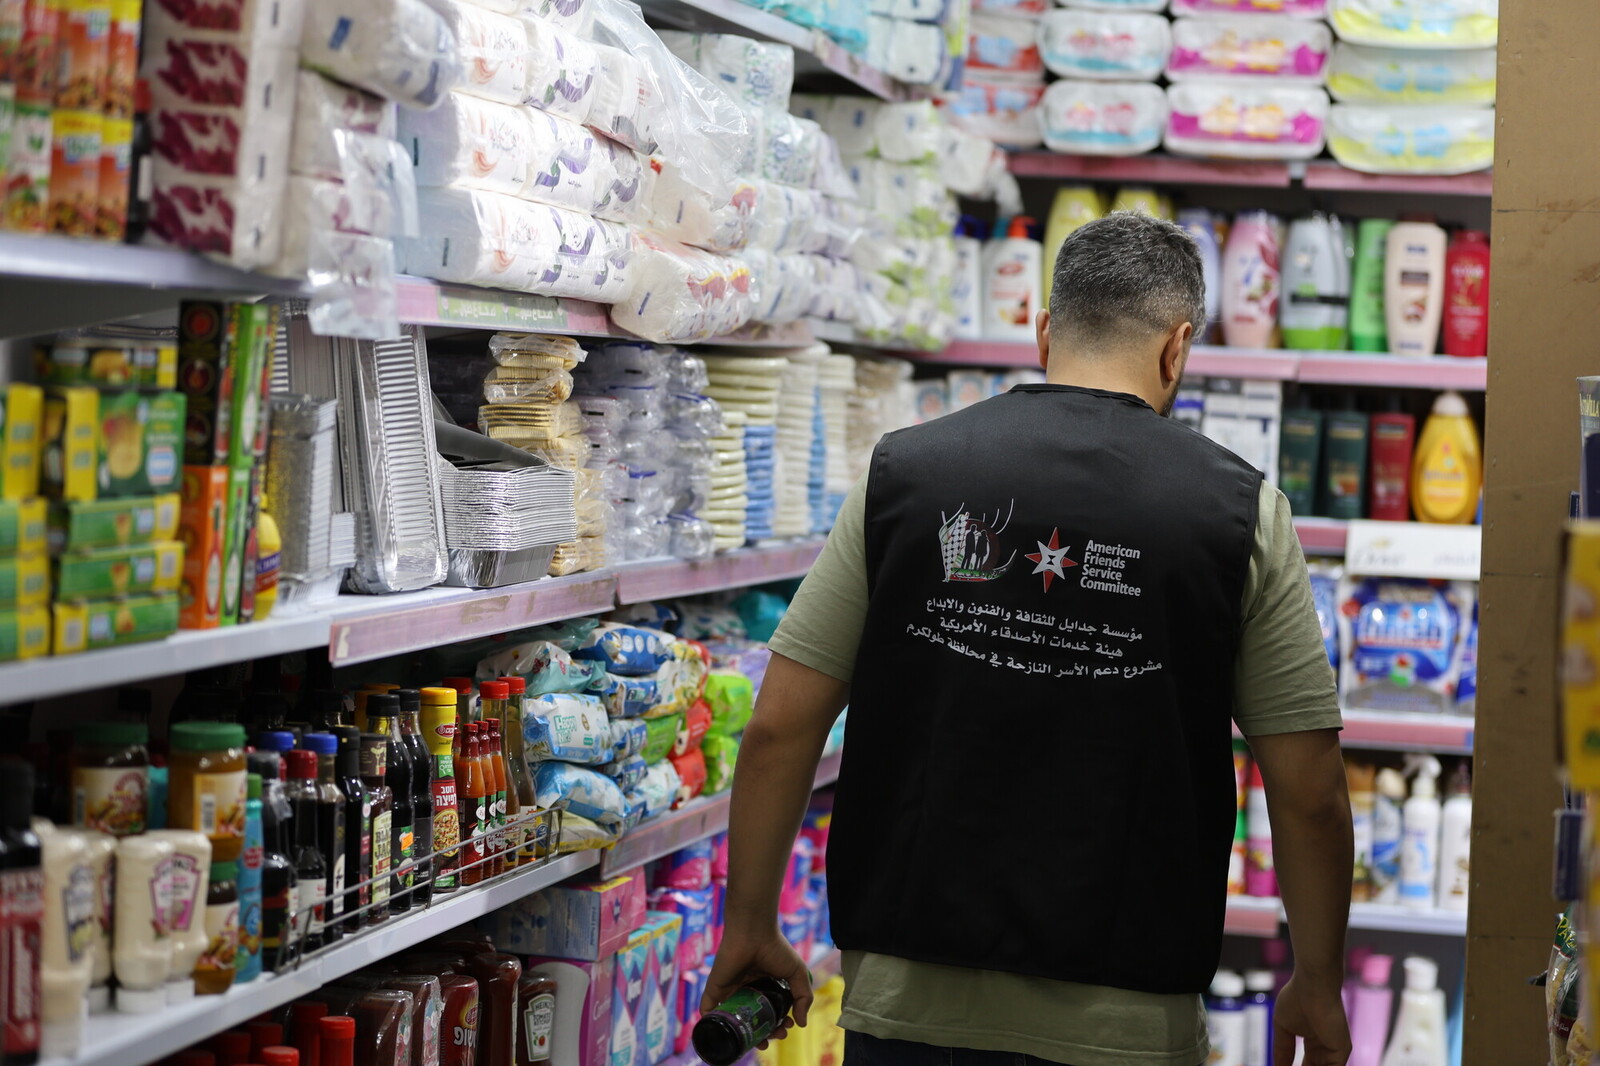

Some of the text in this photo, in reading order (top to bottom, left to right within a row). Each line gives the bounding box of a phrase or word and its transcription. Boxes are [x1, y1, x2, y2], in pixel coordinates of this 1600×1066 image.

[1086, 540, 1141, 559] American
[1084, 552, 1126, 569] Friends
[1082, 564, 1122, 581] Service
[1080, 576, 1141, 597] Committee
[967, 602, 1011, 621] والفنون
[1015, 610, 1056, 627] للثقافة
[1058, 618, 1097, 636] جدايل
[1102, 624, 1143, 642] مؤسسة
[940, 616, 1123, 659] هيئة خدمات الأصدقاء الأمريكية
[906, 623, 1162, 679] مشروع دعم الأسر النازحة في محافظة طولكرم
[535, 1001, 555, 1010] HEINZ
[533, 1012, 552, 1021] TOMATO
